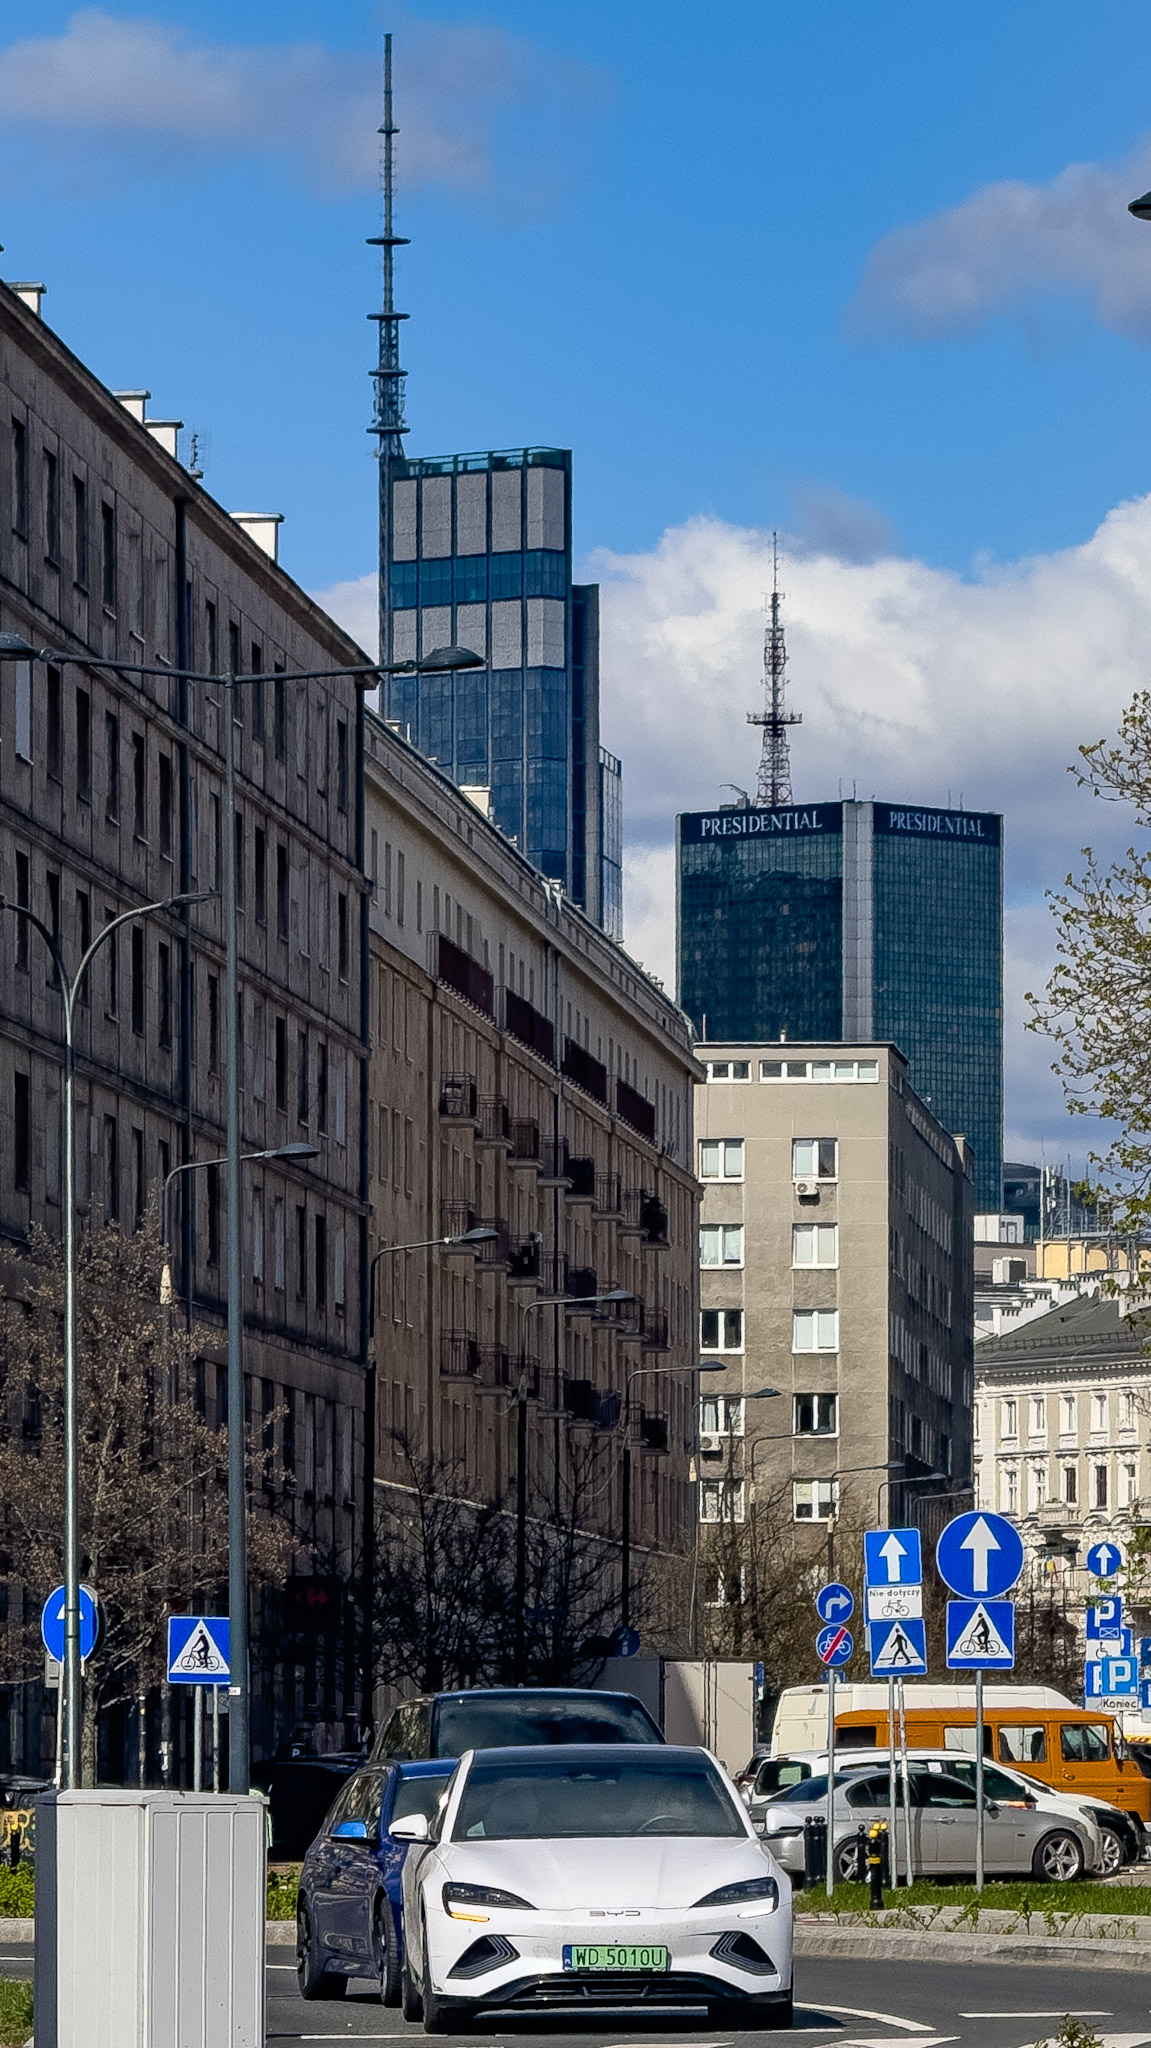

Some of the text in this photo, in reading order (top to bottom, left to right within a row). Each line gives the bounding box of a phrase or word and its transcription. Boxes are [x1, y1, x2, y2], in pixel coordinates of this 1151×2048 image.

[701, 810, 823, 837] PRESIDENTIAL
[888, 810, 986, 838] PRESIDENTIAL
[887, 1589, 920, 1598] dotyczy
[1094, 1600, 1115, 1628] P
[1109, 1660, 1131, 1692] P
[1102, 1698, 1137, 1709] Koniec
[576, 1948, 662, 1966] WD 5010U
